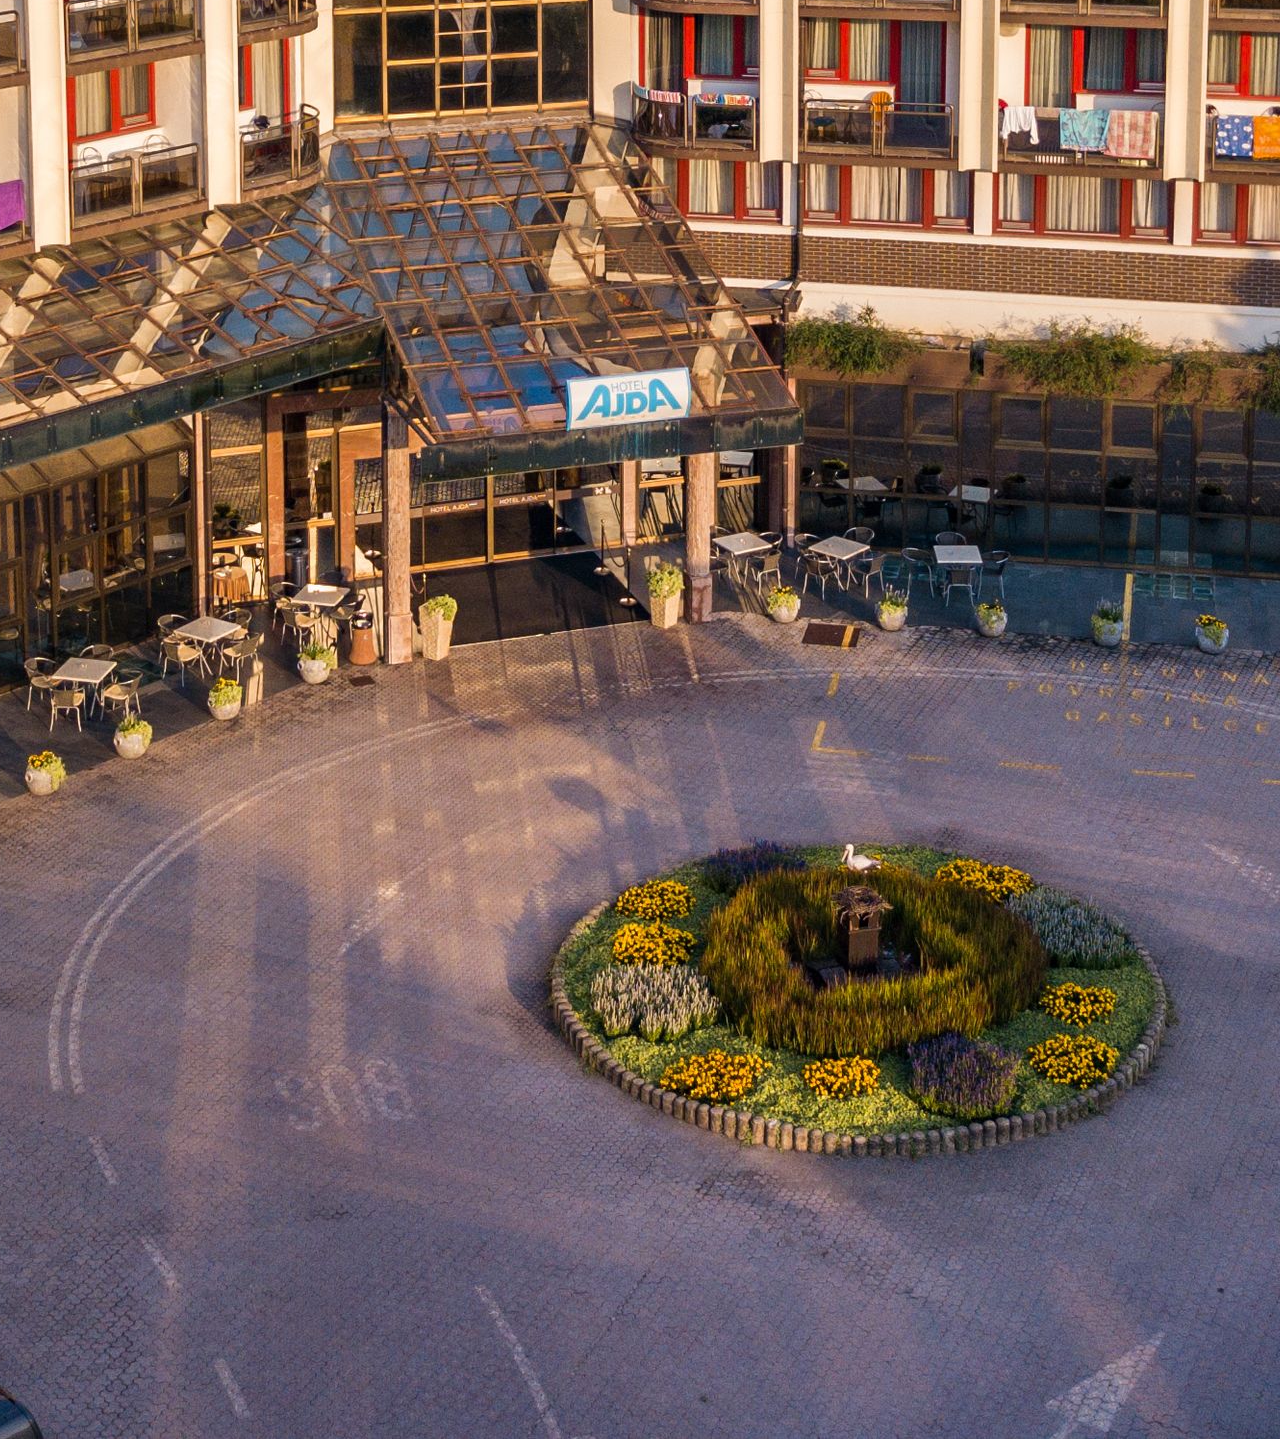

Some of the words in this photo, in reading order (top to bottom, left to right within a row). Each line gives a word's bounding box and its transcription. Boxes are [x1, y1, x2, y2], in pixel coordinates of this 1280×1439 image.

[611, 380, 648, 393] HOTEL
[575, 378, 682, 421] AJDA
[500, 496, 520, 504] HOTEL
[430, 505, 451, 514] HOTEL
